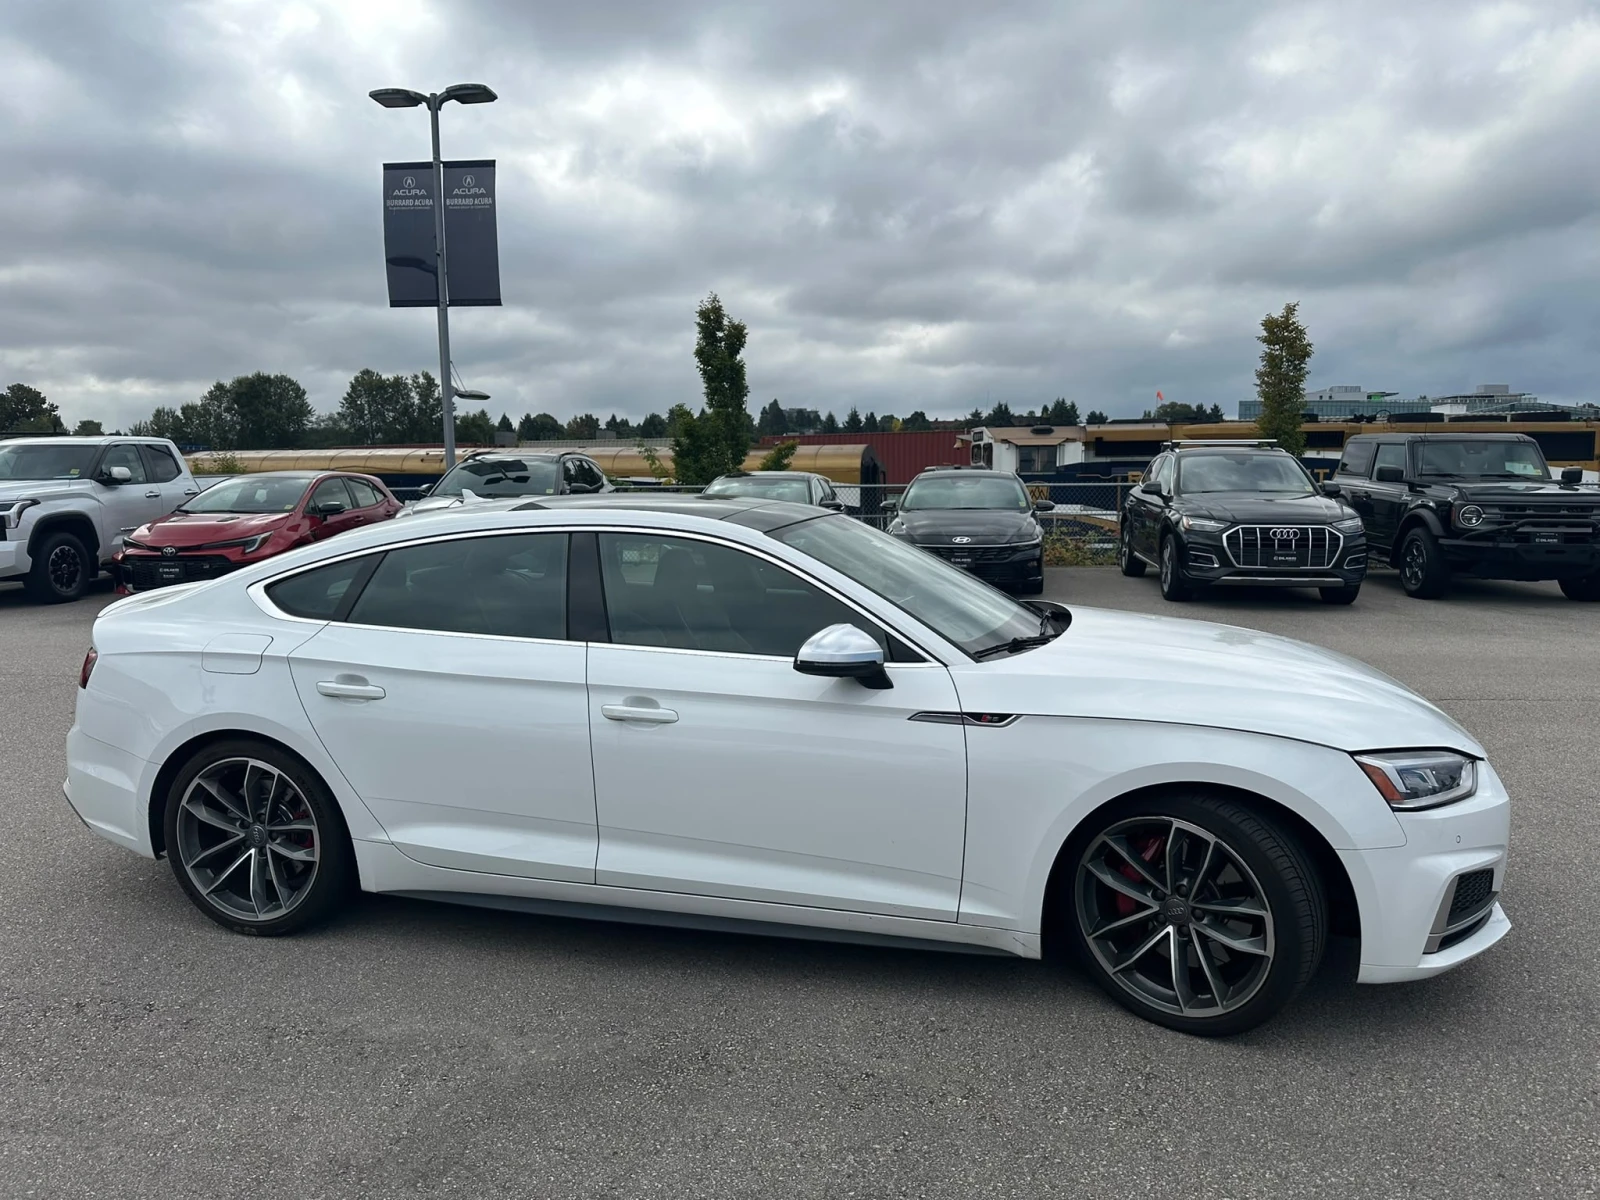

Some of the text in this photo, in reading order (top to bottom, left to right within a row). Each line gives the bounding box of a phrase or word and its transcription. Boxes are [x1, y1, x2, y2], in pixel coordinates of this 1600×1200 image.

[452, 187, 487, 195] ACURA
[414, 198, 433, 206] ACURA
[474, 197, 492, 205] ACURA
